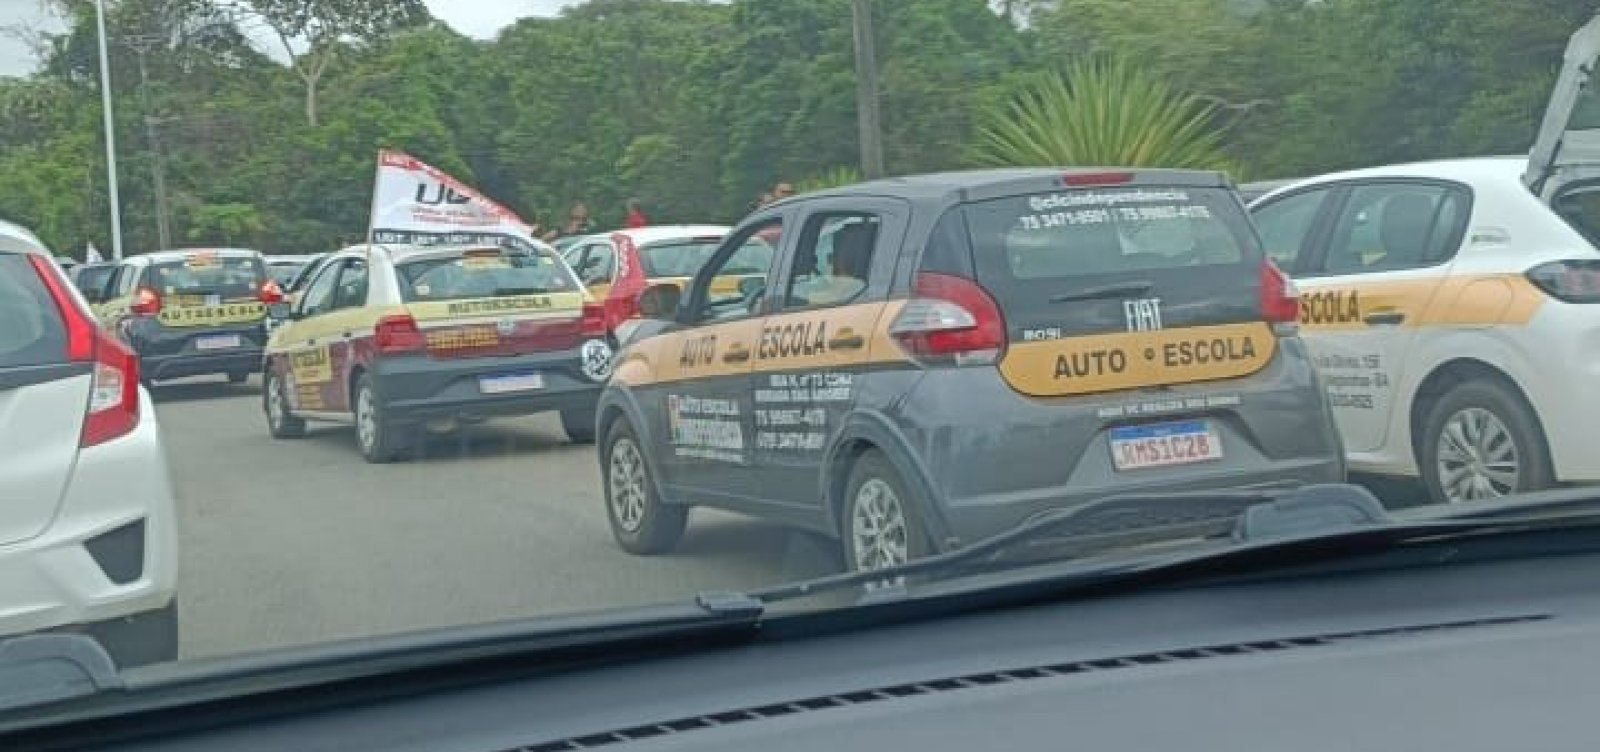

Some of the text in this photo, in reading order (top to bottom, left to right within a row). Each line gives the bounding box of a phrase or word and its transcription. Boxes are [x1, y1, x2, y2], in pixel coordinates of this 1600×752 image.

[447, 296, 552, 315] AUTOESCOLA
[1123, 298, 1162, 332] FIAT
[679, 320, 827, 368] AUTO ESCOLA
[1053, 336, 1256, 379] AUTO ESCOLA
